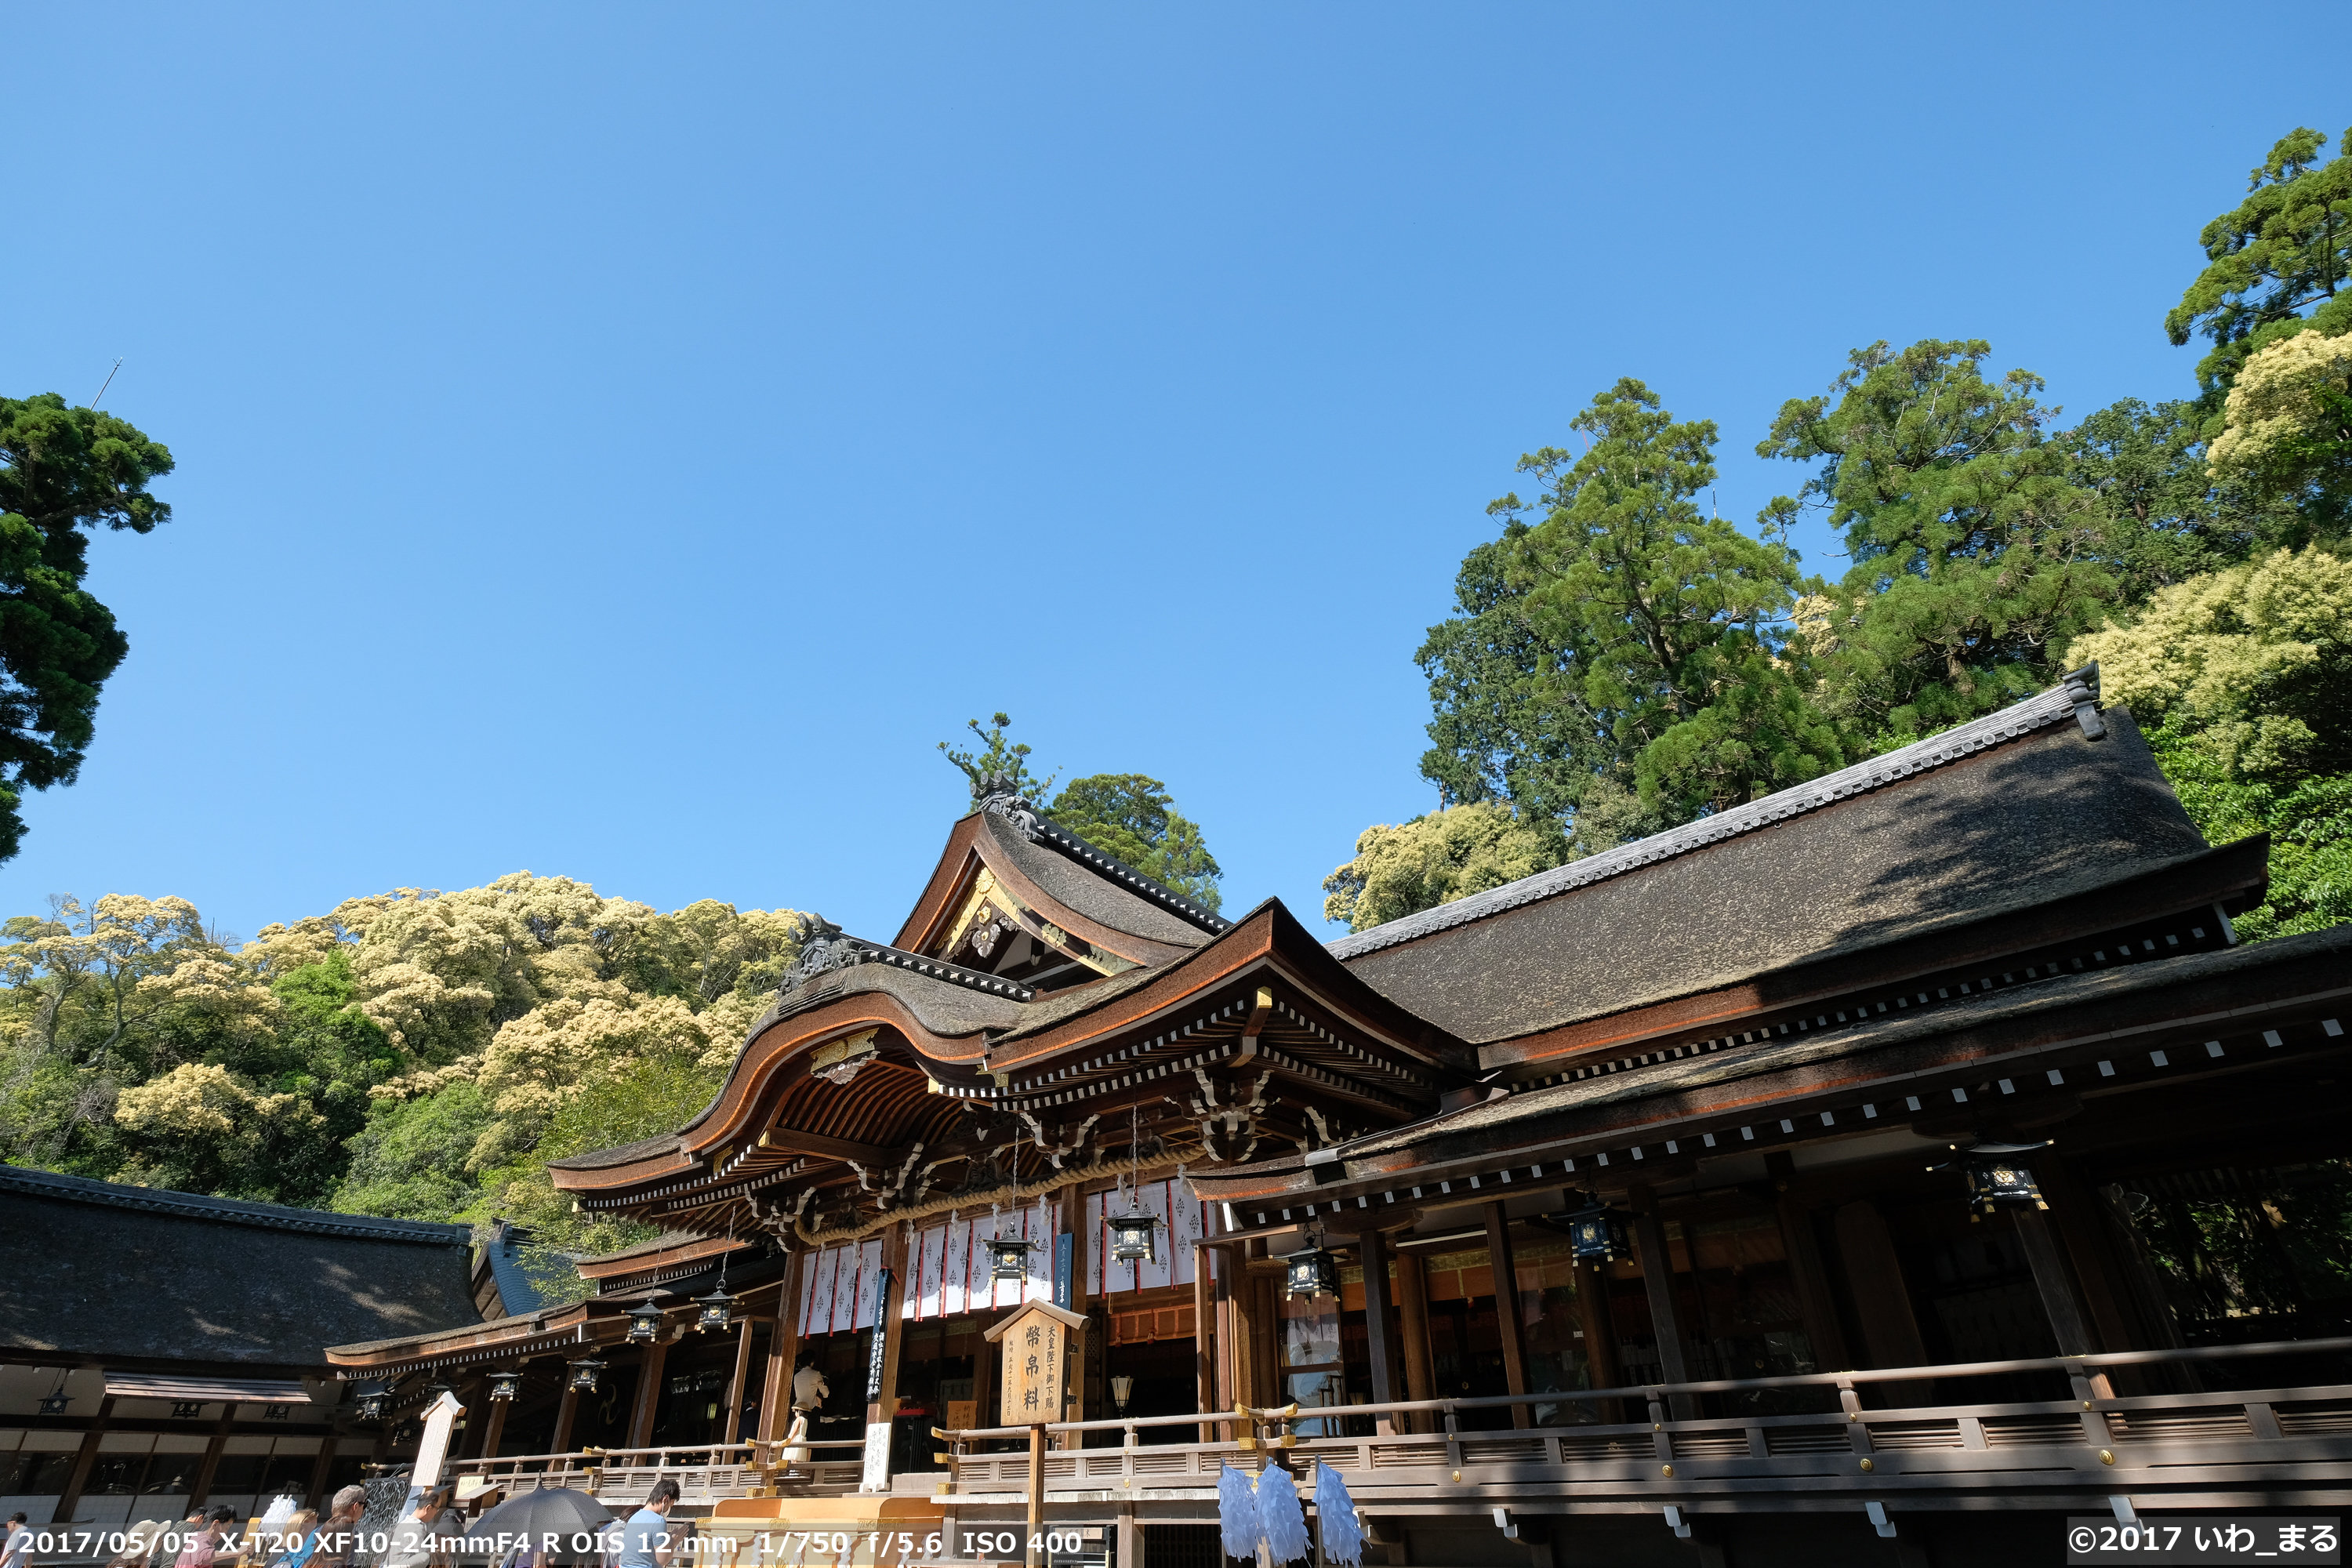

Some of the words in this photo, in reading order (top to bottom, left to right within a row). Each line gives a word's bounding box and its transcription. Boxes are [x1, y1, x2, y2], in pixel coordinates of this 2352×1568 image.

[1023, 1325, 1040, 1412] 幣帛料
[1045, 1326, 1056, 1409] 天皇陛下御下賜
